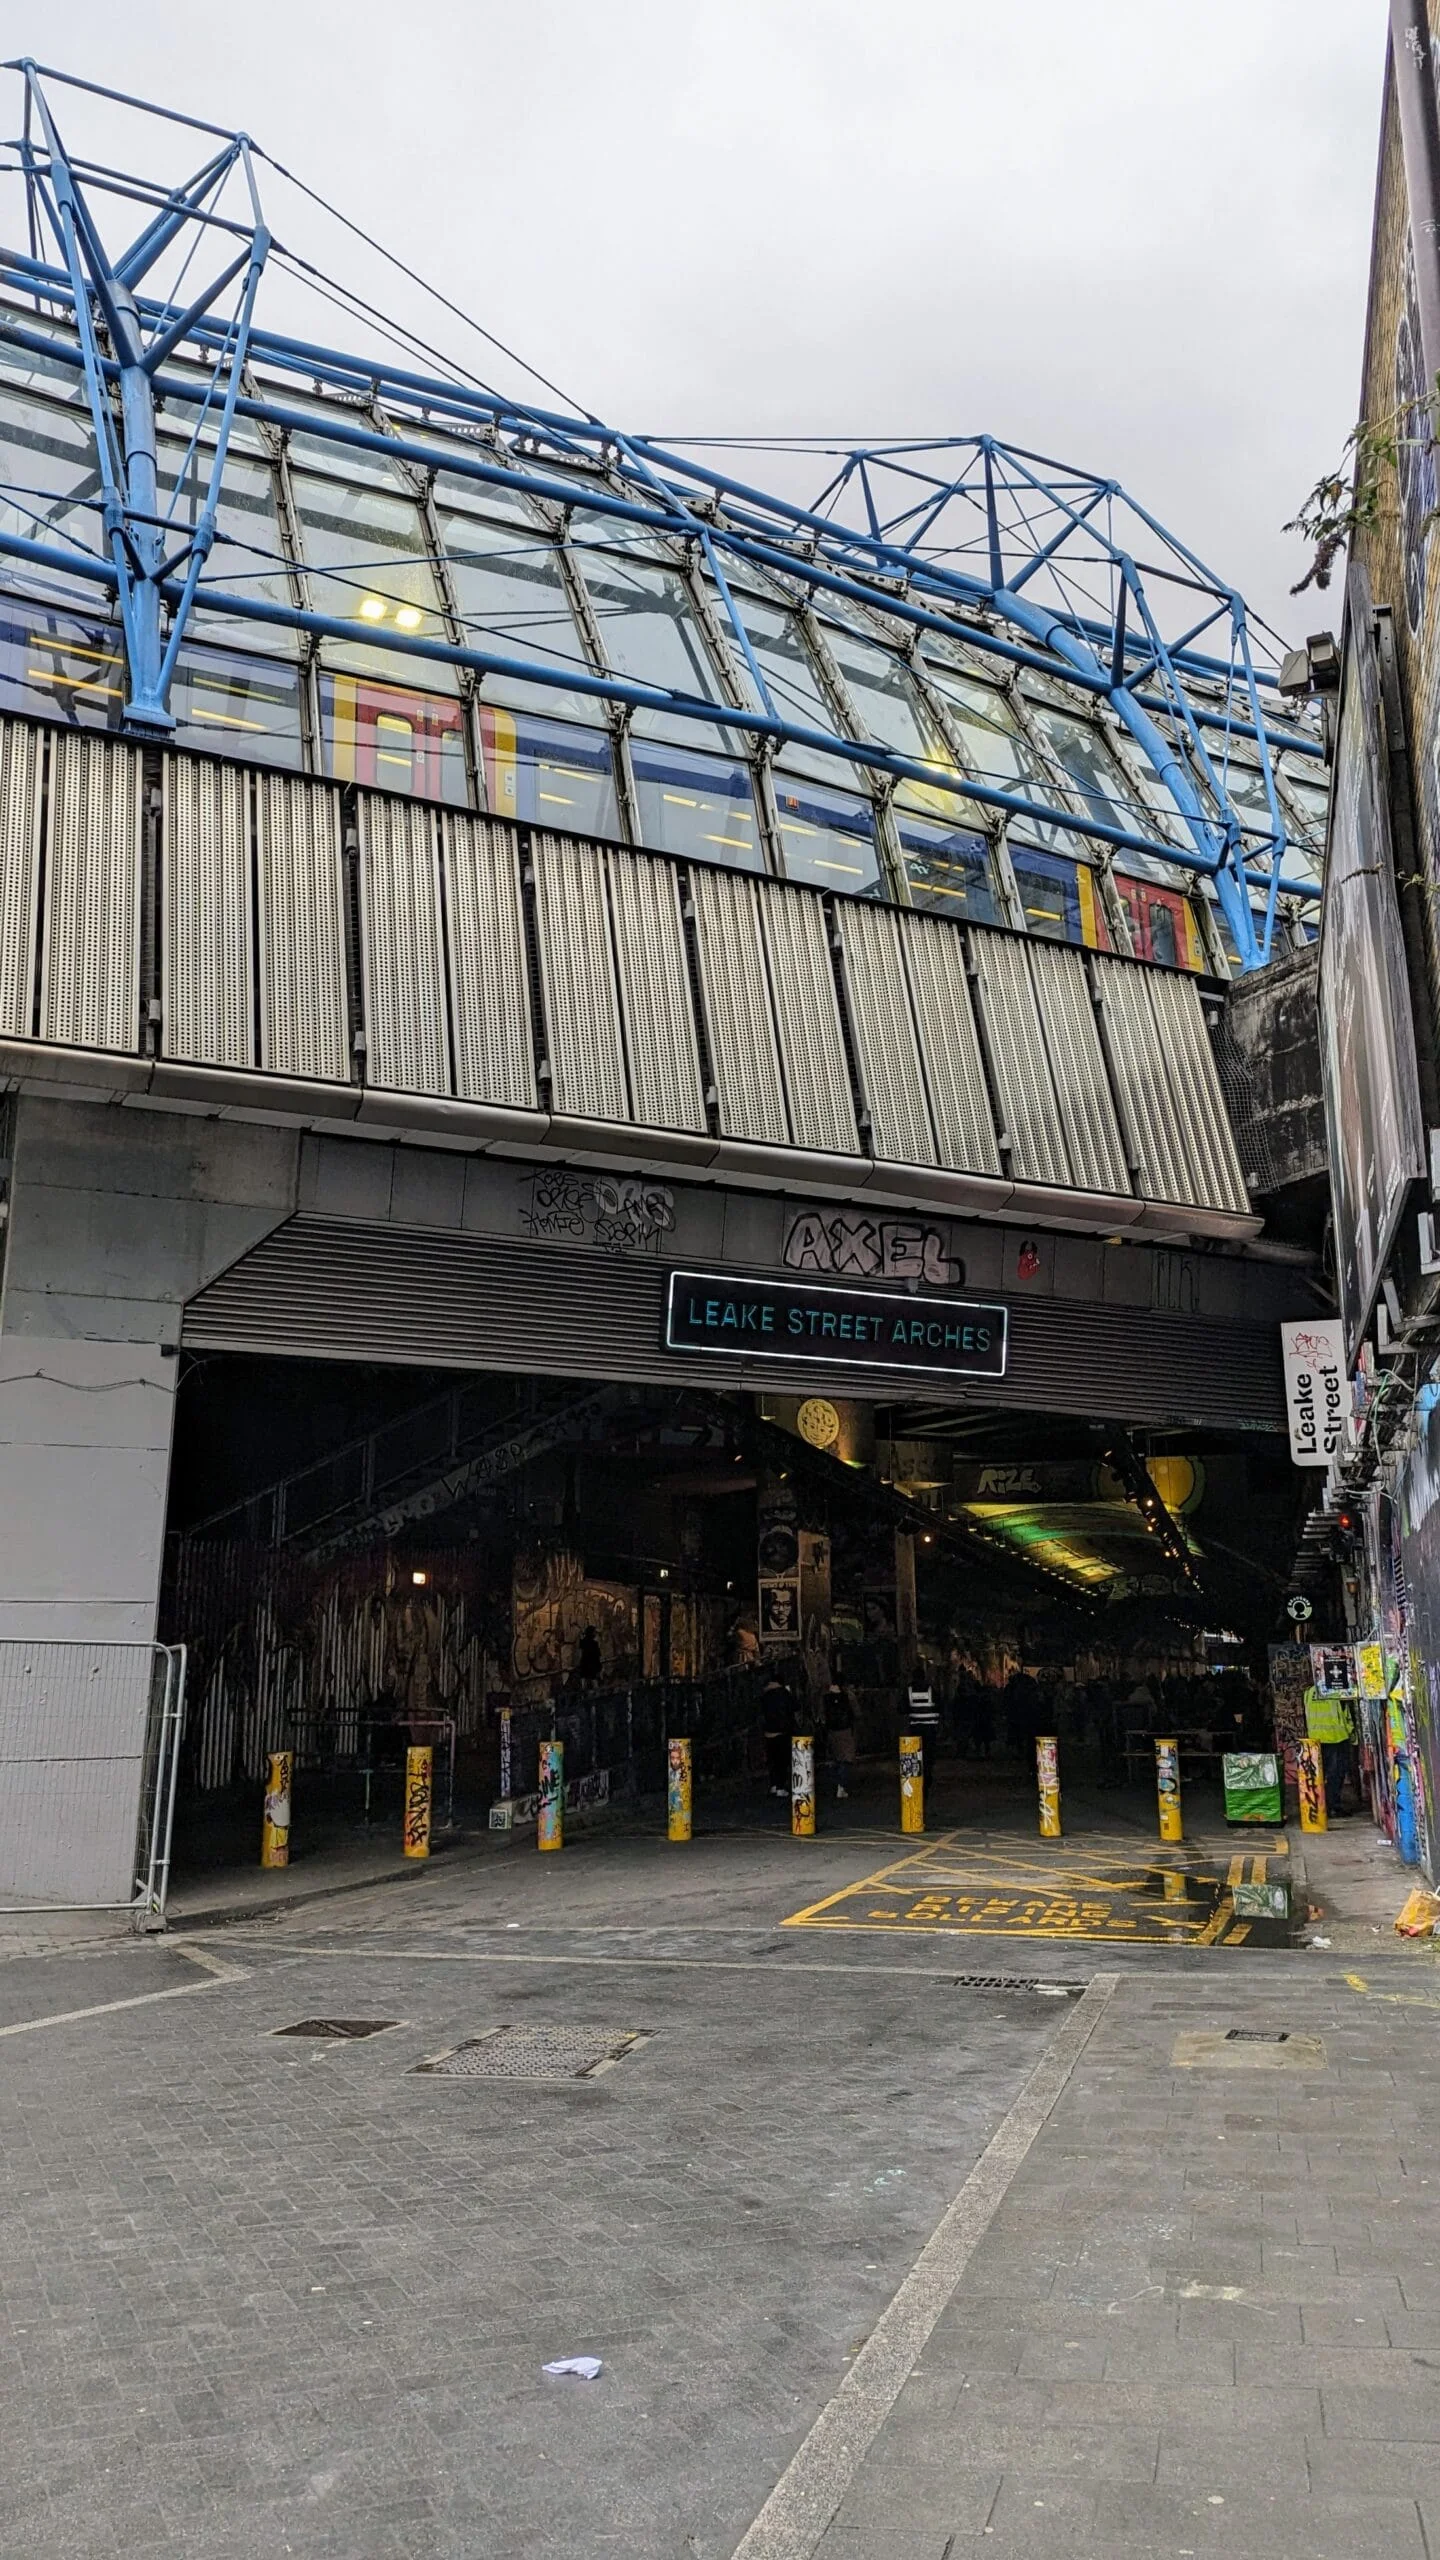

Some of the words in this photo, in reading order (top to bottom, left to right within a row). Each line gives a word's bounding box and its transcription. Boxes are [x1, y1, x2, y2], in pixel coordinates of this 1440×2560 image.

[783, 1213, 965, 1287] AXEL
[689, 1298, 775, 1331] LEAKE
[787, 1308, 883, 1341] STREET
[891, 1319, 991, 1351] ARCHES
[1293, 1373, 1317, 1454] Leake
[1319, 1365, 1342, 1454] Street
[911, 1903, 1112, 1918] RISING
[921, 1895, 1113, 1910] BEWARE
